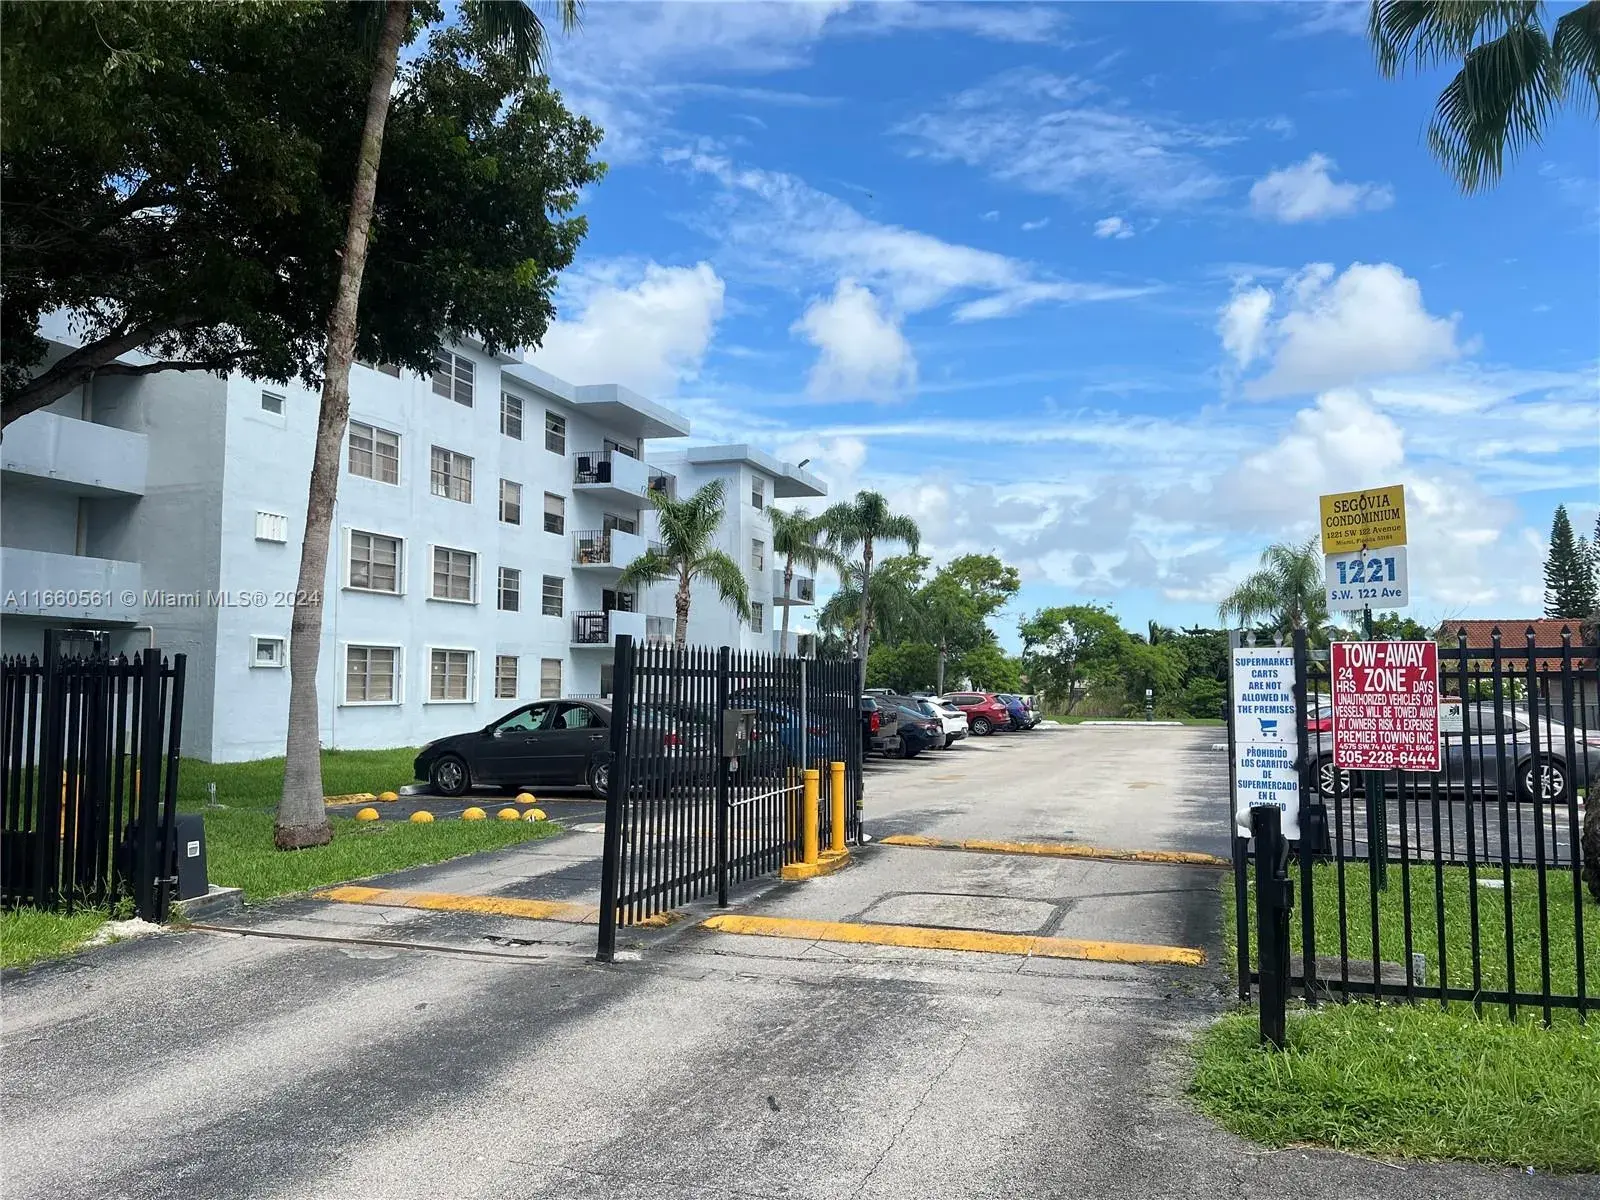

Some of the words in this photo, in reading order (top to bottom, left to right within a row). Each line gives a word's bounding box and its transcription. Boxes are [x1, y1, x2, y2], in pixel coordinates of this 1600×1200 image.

[1334, 494, 1391, 514] SEGOVIA
[1326, 508, 1401, 528] CONDOMINIUM
[1327, 531, 1342, 539] 1221
[1345, 530, 1357, 538] SW
[1360, 528, 1371, 536] 122
[1372, 525, 1402, 534] Avenue
[1336, 557, 1396, 585] 1221
[1331, 590, 1353, 600] S.W.
[1358, 588, 1377, 599] 122
[1381, 587, 1402, 598] Ave
[1235, 657, 1294, 667] SUPERMARKET
[1342, 643, 1426, 668] TOW-AWAY
[1251, 669, 1278, 678] CARTS
[1338, 667, 1353, 680] 24
[1364, 668, 1407, 692] ZONE
[1419, 667, 1428, 680] 7
[1248, 681, 1265, 690] ARE
[1266, 681, 1282, 690] NOT
[1336, 680, 1357, 693] HRS
[1412, 680, 1434, 693] DAYS
[1242, 693, 1279, 702] ALLOWED
[1280, 693, 1289, 702] IN
[1337, 693, 1386, 705] UNAUTHORIZED
[1389, 693, 1421, 706] VEHICLES
[1423, 694, 1433, 706] OR
[1237, 705, 1253, 714] THE
[1255, 705, 1295, 714] PREMISES
[1335, 706, 1364, 718] VESSELS
[1366, 706, 1382, 718] WILL
[1383, 706, 1392, 718] BE
[1394, 706, 1417, 718] TOWED
[1419, 707, 1436, 718] AWAY
[1338, 718, 1347, 730] AT
[1348, 718, 1377, 730] OWNERS
[1378, 719, 1394, 731] RISK
[1396, 719, 1402, 731] &
[1403, 719, 1434, 731] EXPENSE
[1337, 731, 1377, 743] PREMIER
[1379, 731, 1415, 744] TOWING
[1416, 732, 1436, 745] INC.
[1246, 748, 1288, 758] PROHIBIDO
[1338, 751, 1436, 765] 305-228-6444
[1241, 758, 1255, 768] LOS
[1256, 759, 1294, 769] CARRITOS
[1262, 770, 1272, 779] DE
[1237, 780, 1297, 790] SUPERMERCADO
[1258, 791, 1268, 800] EN
[1269, 791, 1277, 800] EL
